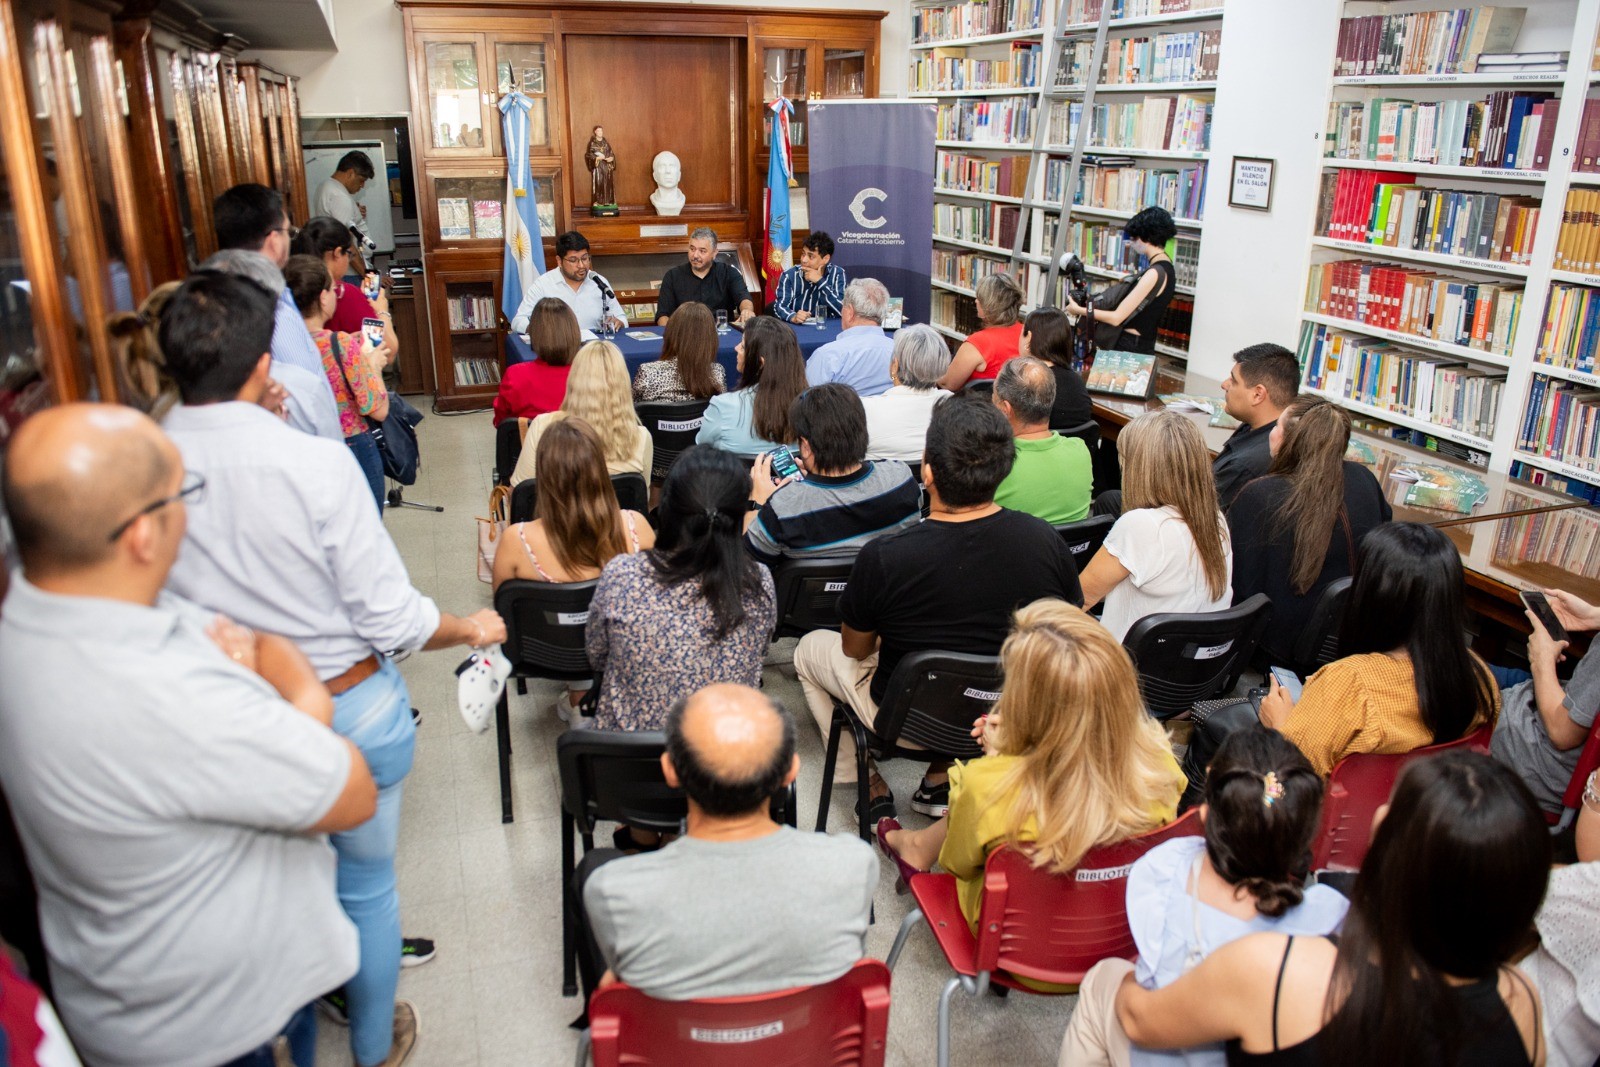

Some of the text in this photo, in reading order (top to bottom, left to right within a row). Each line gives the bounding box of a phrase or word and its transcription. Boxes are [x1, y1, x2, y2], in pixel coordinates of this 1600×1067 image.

[1314, 132, 1319, 140] 8
[1562, 147, 1570, 156] 9
[1240, 165, 1267, 173] MANTENER
[1242, 172, 1264, 180] SILENCIO
[841, 231, 900, 240] Vicegobernación
[837, 237, 905, 246] Catamarca Gobierno
[1459, 259, 1480, 267] DERECHO
[660, 420, 703, 430] BIBLIOTECA
[696, 1022, 778, 1040] BIBLIOTECA
